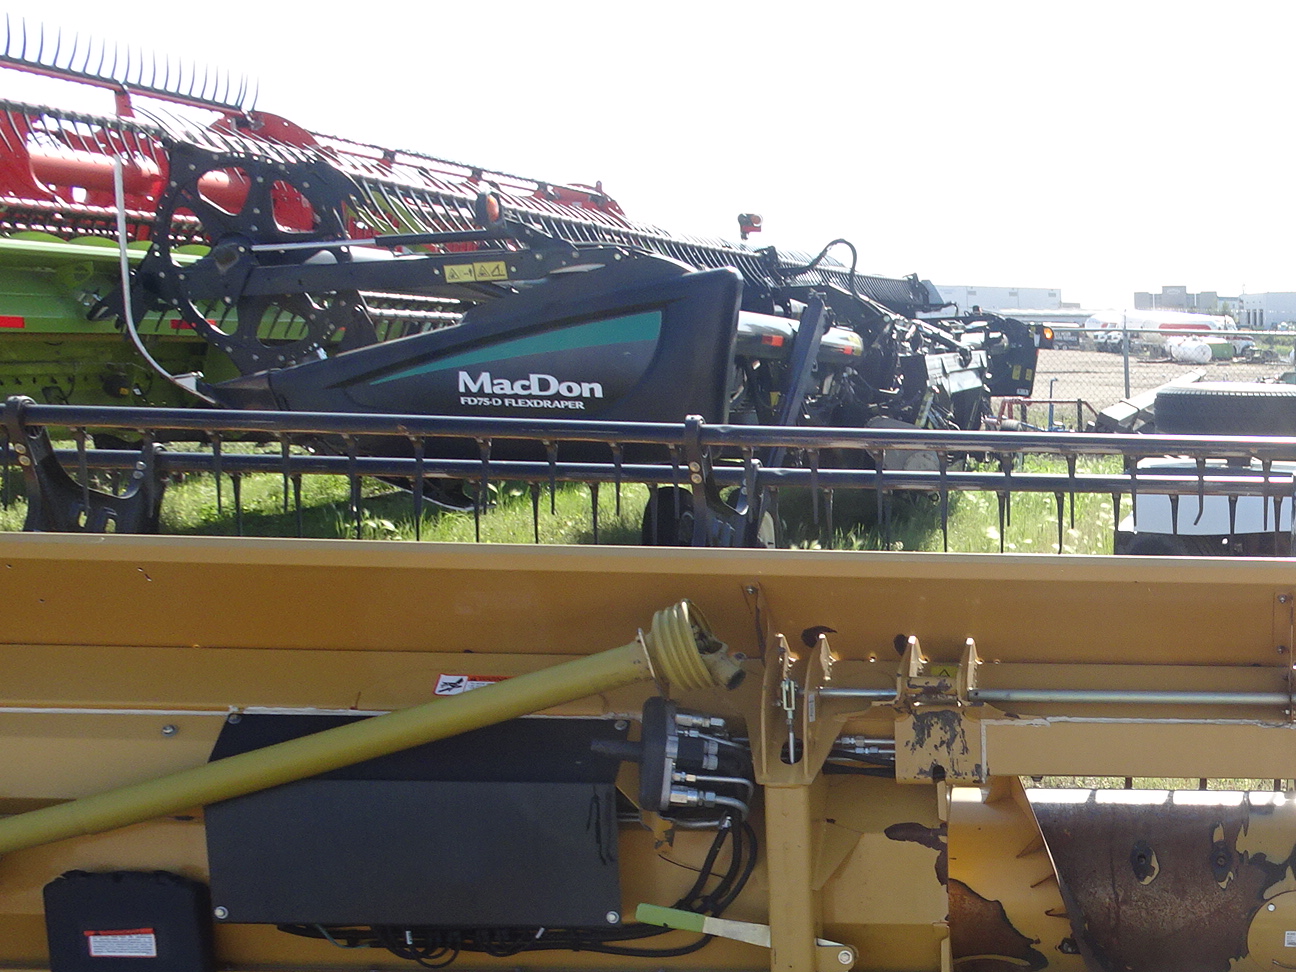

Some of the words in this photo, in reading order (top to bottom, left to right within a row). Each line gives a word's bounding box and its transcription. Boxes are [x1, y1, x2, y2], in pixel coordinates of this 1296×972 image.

[458, 370, 604, 398] MacDon
[460, 396, 502, 407] FD75-D
[504, 398, 586, 410] FLEXDRAPER
